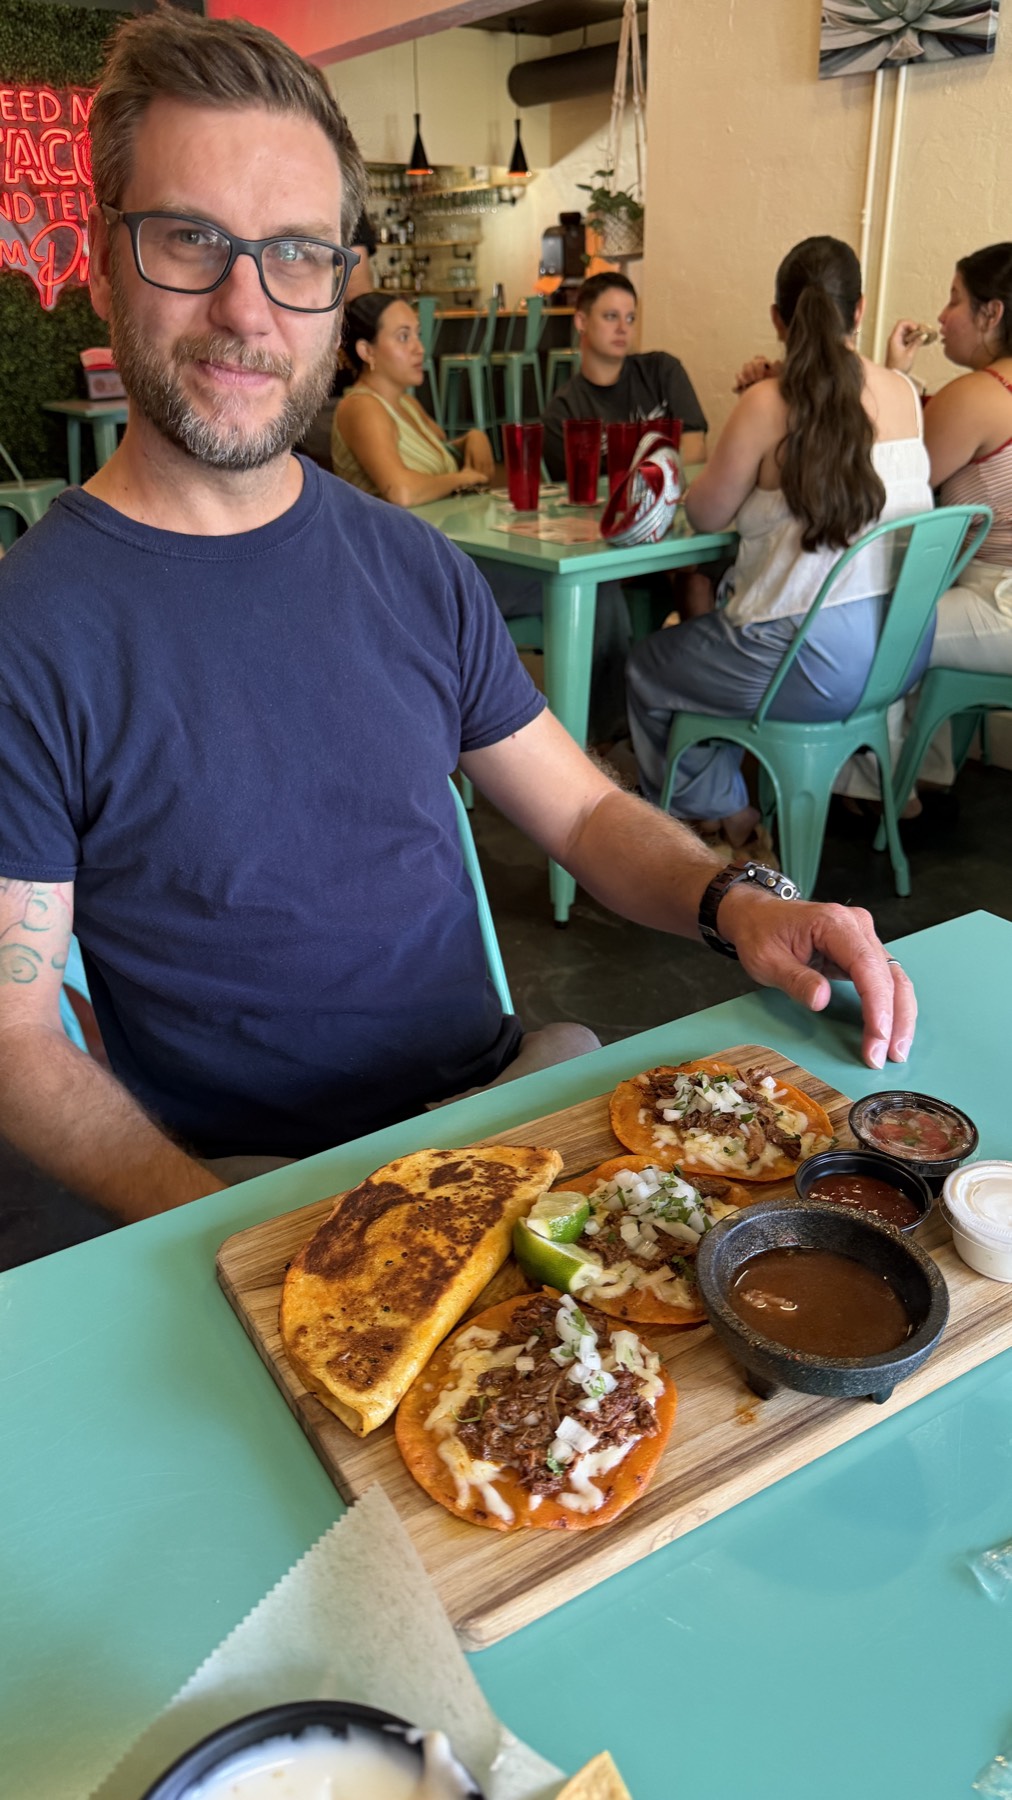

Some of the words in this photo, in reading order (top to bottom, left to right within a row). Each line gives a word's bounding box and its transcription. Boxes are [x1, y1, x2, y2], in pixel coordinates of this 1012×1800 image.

[0, 89, 62, 123] EED
[0, 191, 35, 224] ND
[40, 190, 88, 221] TEL
